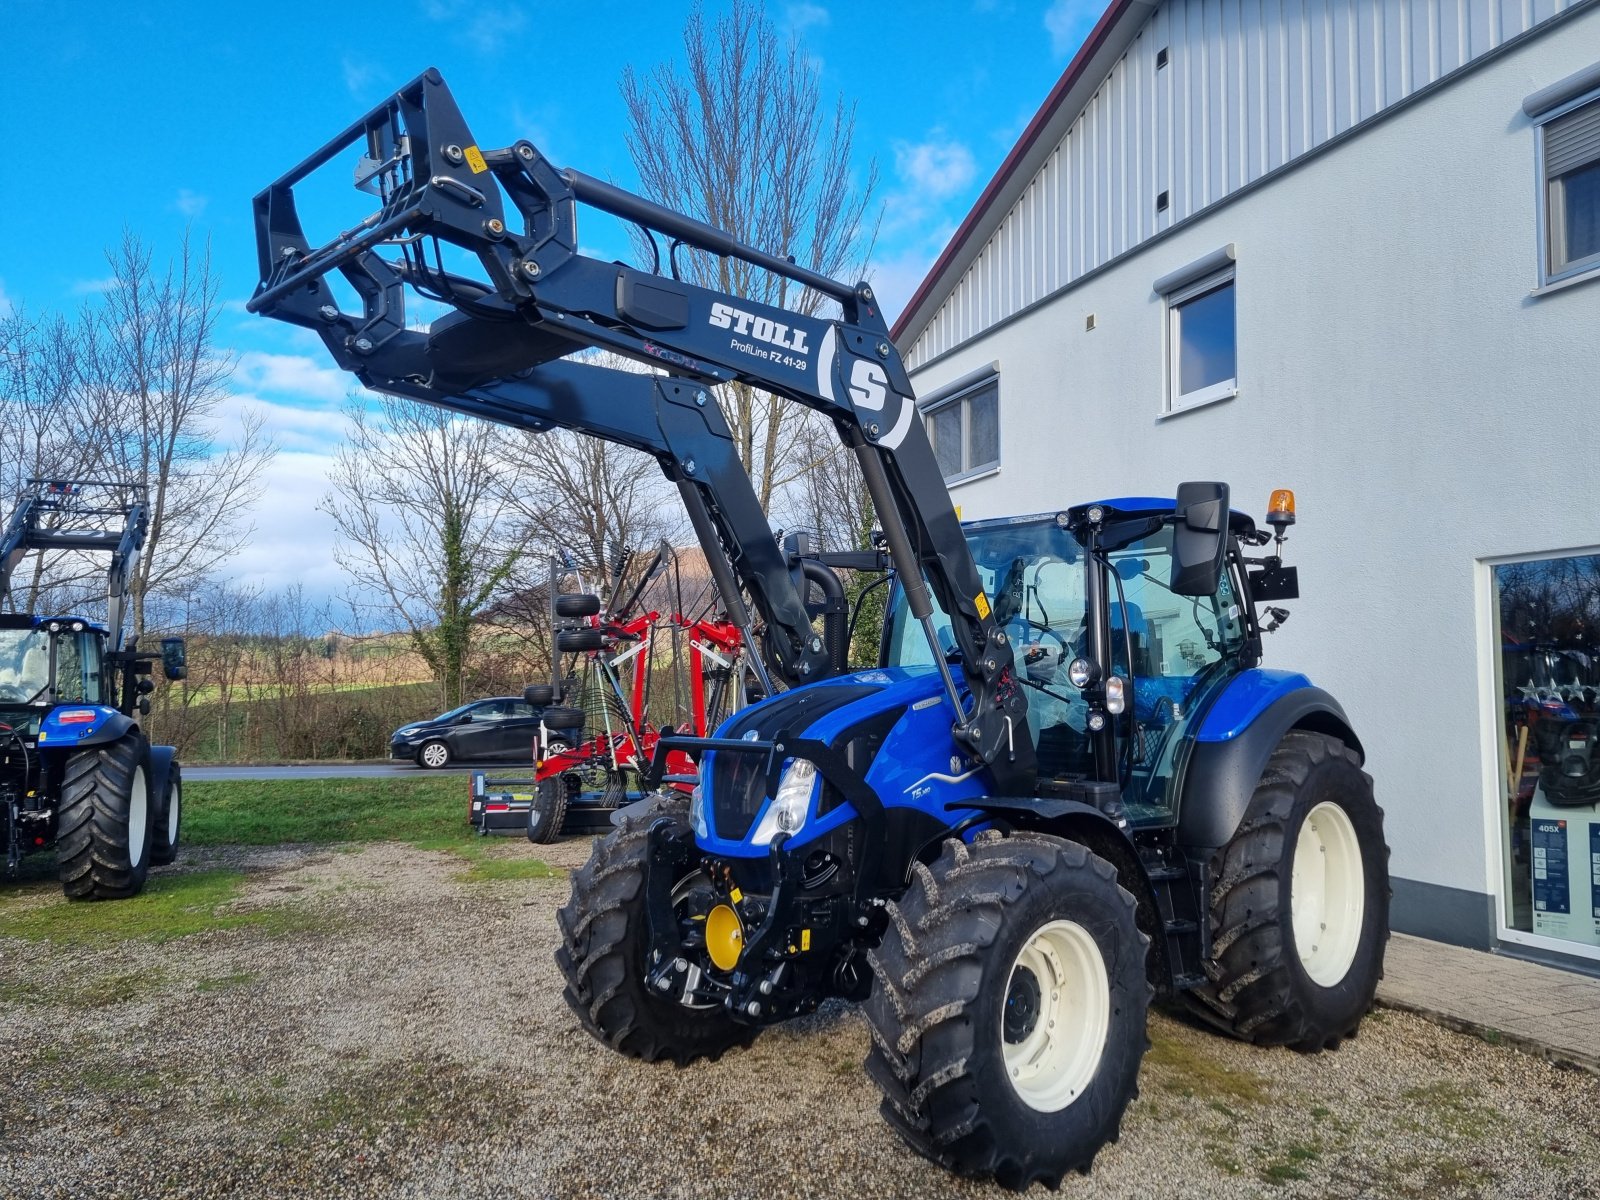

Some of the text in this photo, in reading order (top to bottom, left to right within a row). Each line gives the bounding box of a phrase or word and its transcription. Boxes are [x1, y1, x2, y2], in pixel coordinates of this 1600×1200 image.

[708, 302, 809, 355] STOLL
[730, 339, 807, 371] ProfiLine FZ 41-29
[849, 360, 888, 411] S
[1538, 824, 1560, 833] 405X
